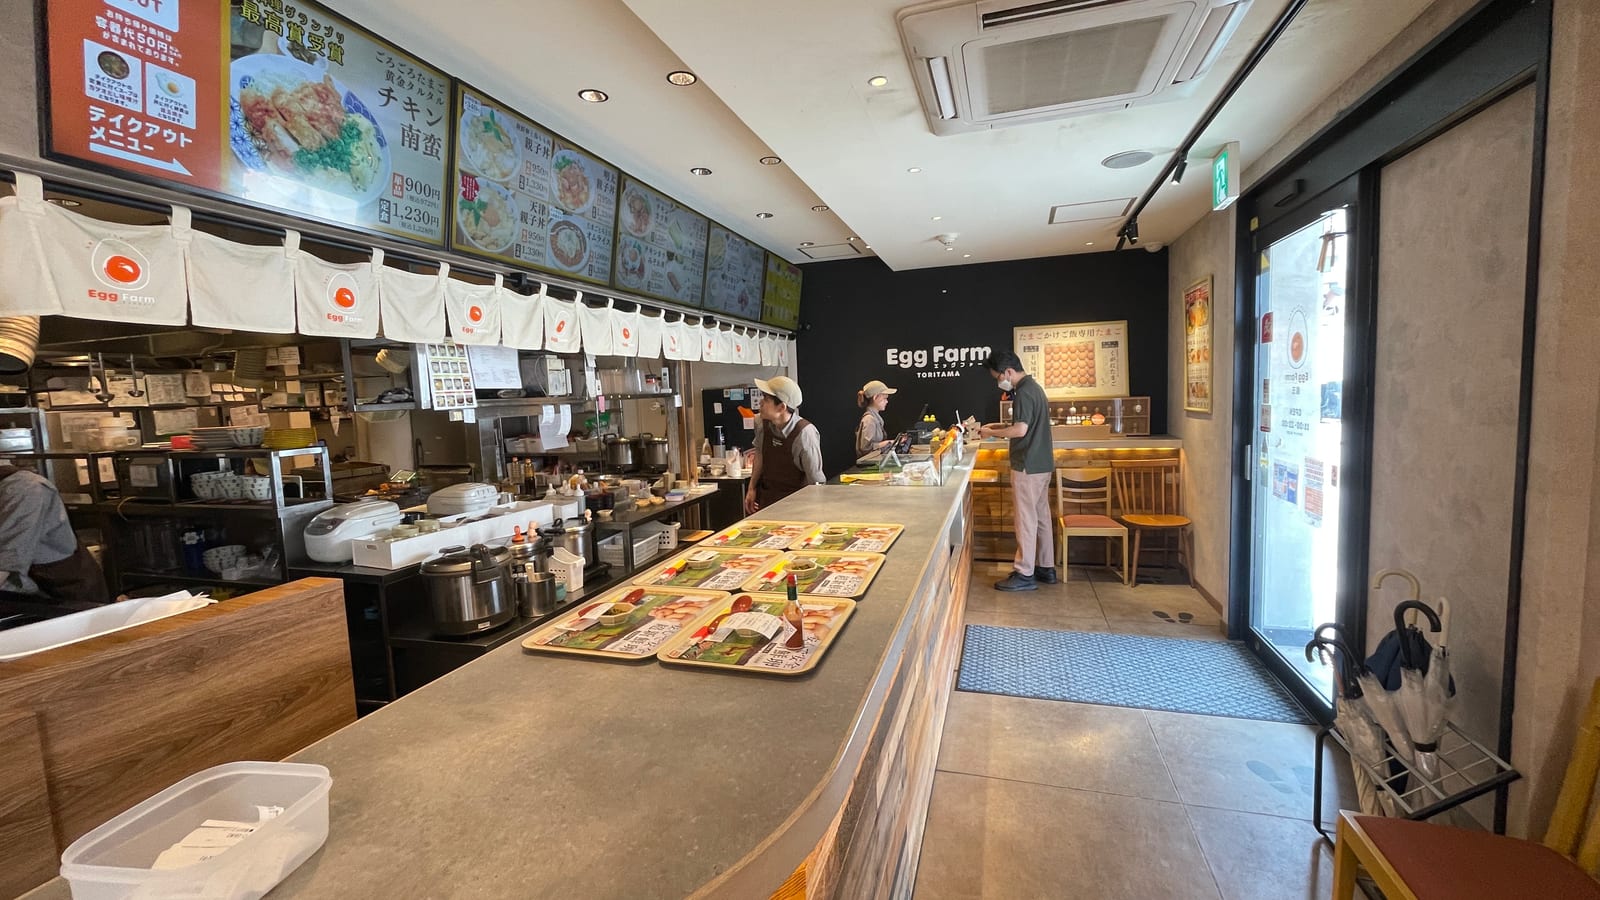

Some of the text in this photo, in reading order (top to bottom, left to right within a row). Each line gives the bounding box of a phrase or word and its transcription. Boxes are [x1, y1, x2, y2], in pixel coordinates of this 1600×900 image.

[128, 0, 163, 13] UT
[240, 0, 345, 66] 最高賞受賞
[378, 86, 443, 127] チキン
[89, 105, 193, 148] テイクアウト
[89, 126, 154, 151] メニュー
[400, 122, 442, 161] 南蛮
[405, 176, 440, 201] 900円
[392, 202, 440, 228] 1,230円
[88, 289, 155, 303] Egg Farm
[327, 312, 344, 323] Egg
[1020, 327, 1122, 341] たまごかけご飯専用たまご
[887, 345, 992, 368] Egg Farm
[917, 370, 960, 378] TORITAMA
